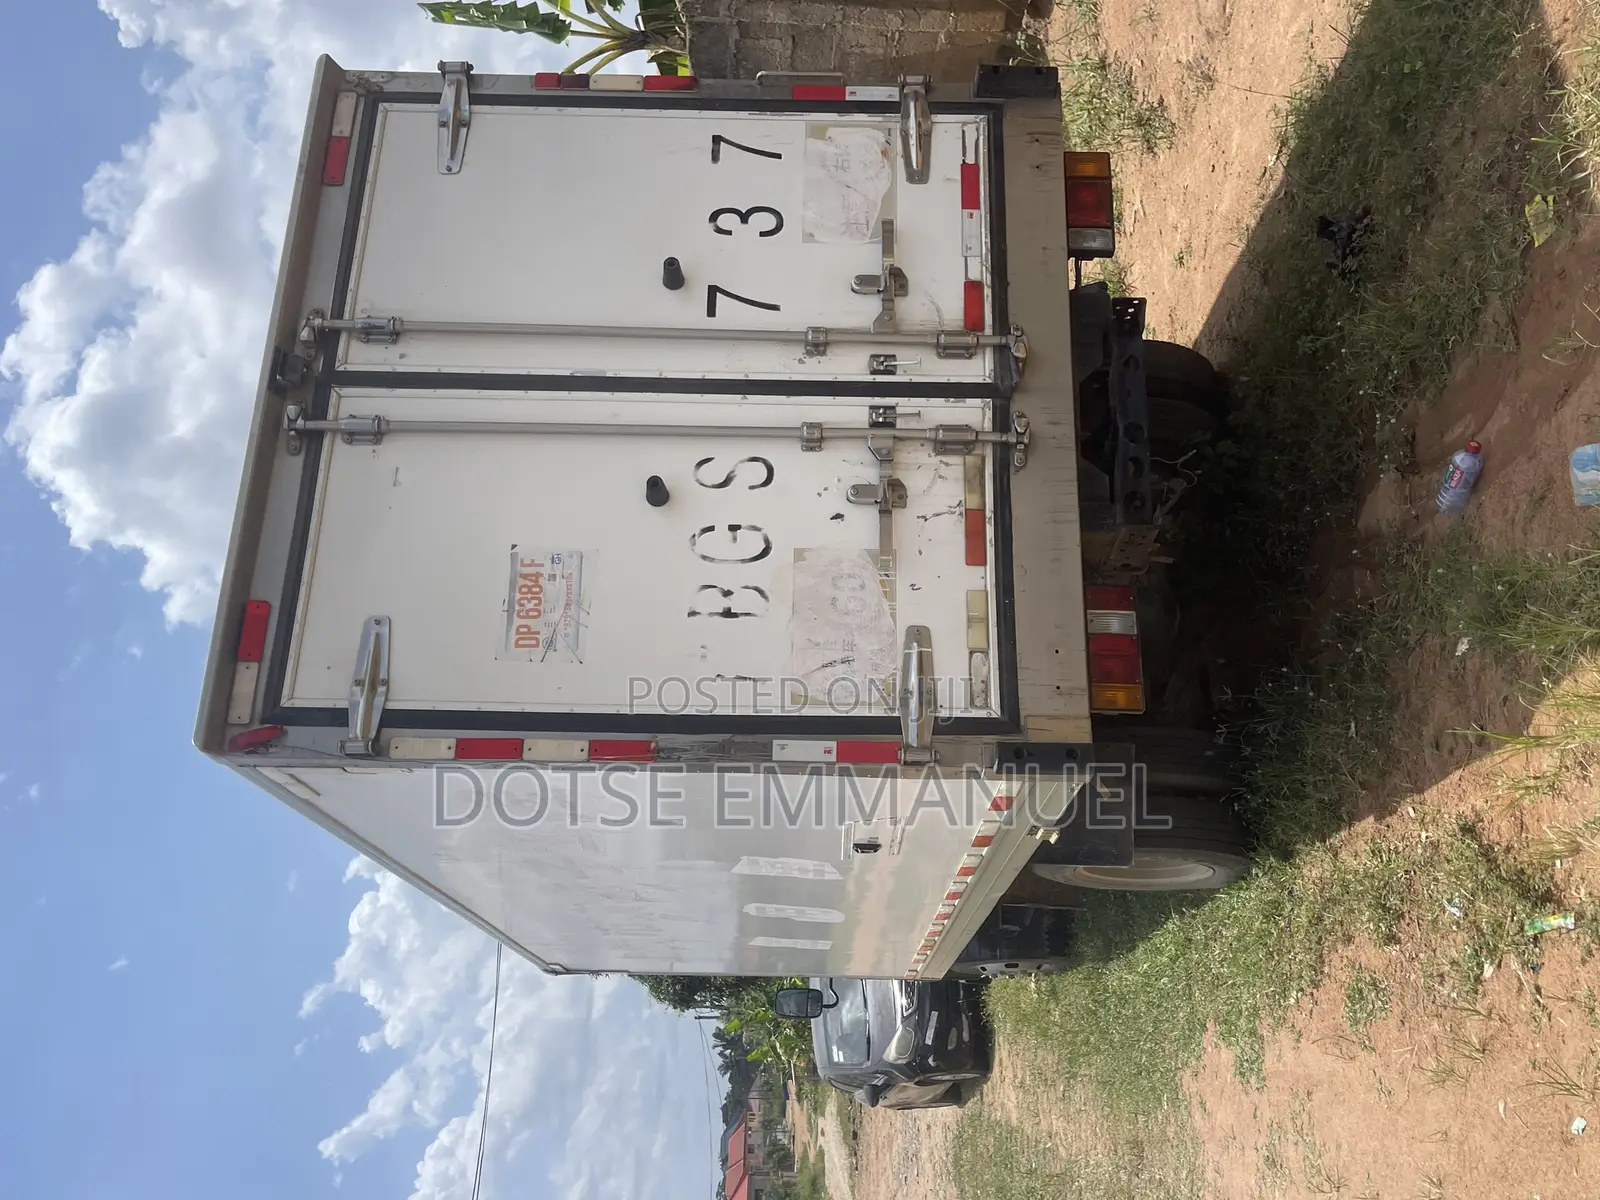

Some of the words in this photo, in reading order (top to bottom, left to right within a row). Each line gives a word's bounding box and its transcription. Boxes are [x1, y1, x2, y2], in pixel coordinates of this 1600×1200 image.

[519, 557, 544, 568] F
[516, 571, 544, 619] 6384
[514, 624, 540, 648] DP
